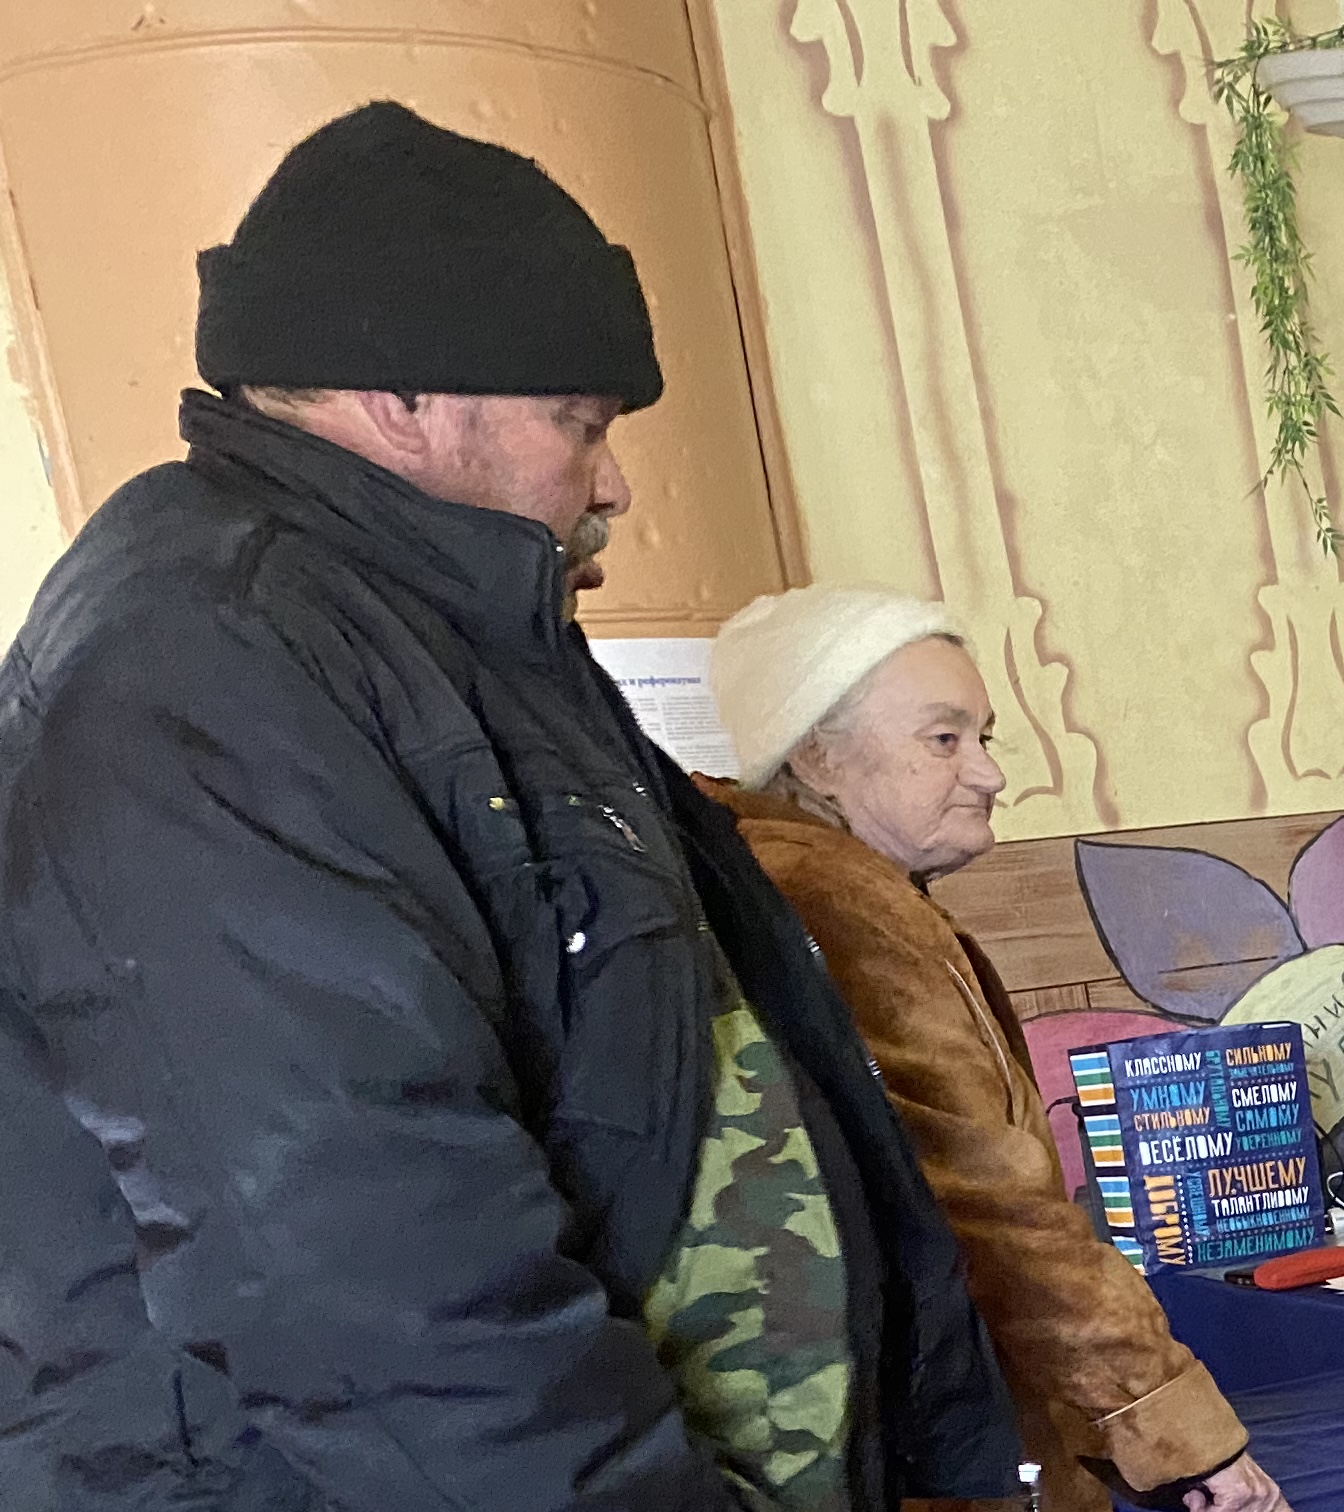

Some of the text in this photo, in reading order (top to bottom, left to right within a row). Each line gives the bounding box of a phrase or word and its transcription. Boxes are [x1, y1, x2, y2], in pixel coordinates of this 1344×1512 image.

[1125, 1052, 1201, 1078] КЛАССНОМУ
[1225, 1042, 1292, 1067] СИЛЬНОМУ
[1130, 1081, 1205, 1111] УМНОМУ
[1232, 1082, 1298, 1108] СМЕЛОМУ
[1134, 1107, 1210, 1132] СТИЛЬНОМУ
[1236, 1104, 1299, 1132] САМОМУ
[1139, 1132, 1233, 1166] ВЕСЁЛОМУ
[1236, 1128, 1302, 1153] УВЕРЕННОМУ
[1208, 1157, 1306, 1197] ЛУЧШЕМУ
[1211, 1187, 1309, 1217] ТАЛАНТЛИВОМУ
[1144, 1175, 1186, 1265] ДОБРОМУ
[1216, 1205, 1310, 1233] НЕОБЫКНОВЕННОМУ
[1197, 1226, 1315, 1262] НЕЗАМЕНИМОМУ
